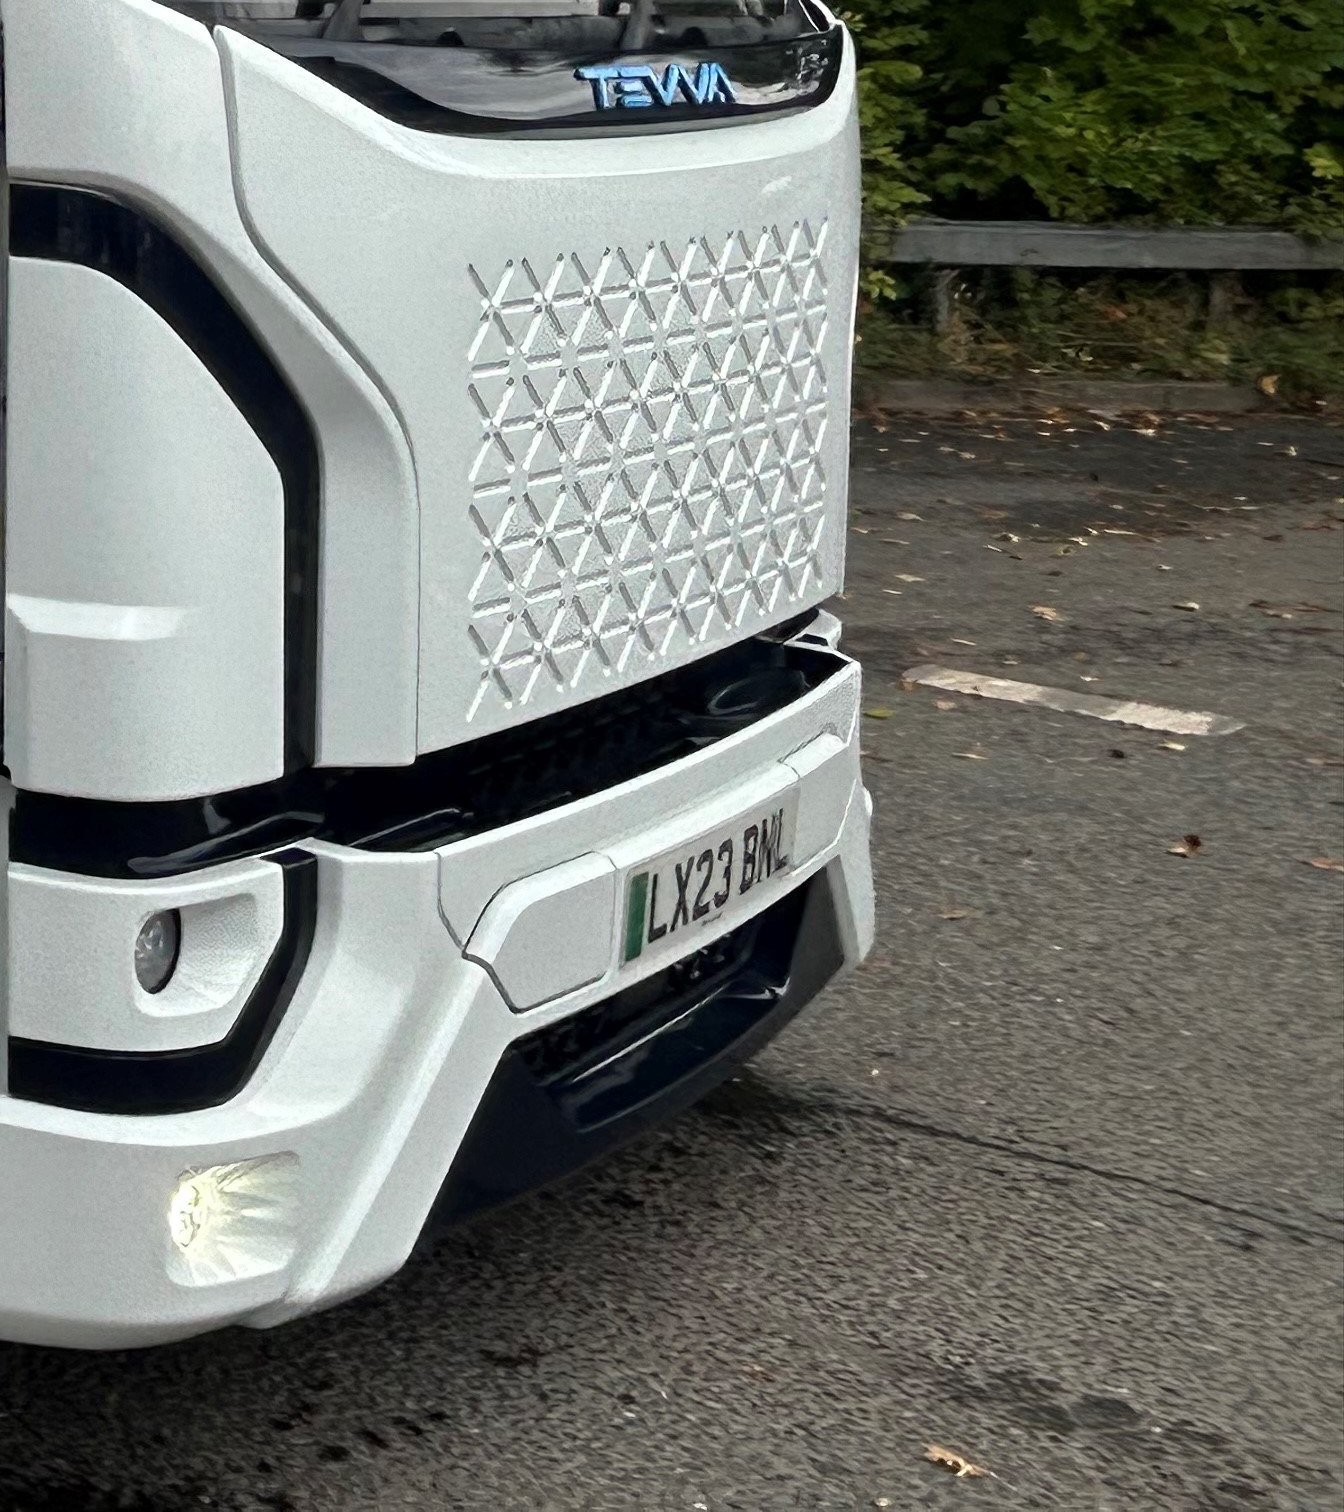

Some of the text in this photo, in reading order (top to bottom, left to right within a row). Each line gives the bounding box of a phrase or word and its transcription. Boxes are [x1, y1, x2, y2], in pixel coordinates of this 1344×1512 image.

[573, 61, 736, 109] TEVVA
[647, 808, 788, 944] LX23 BNL
